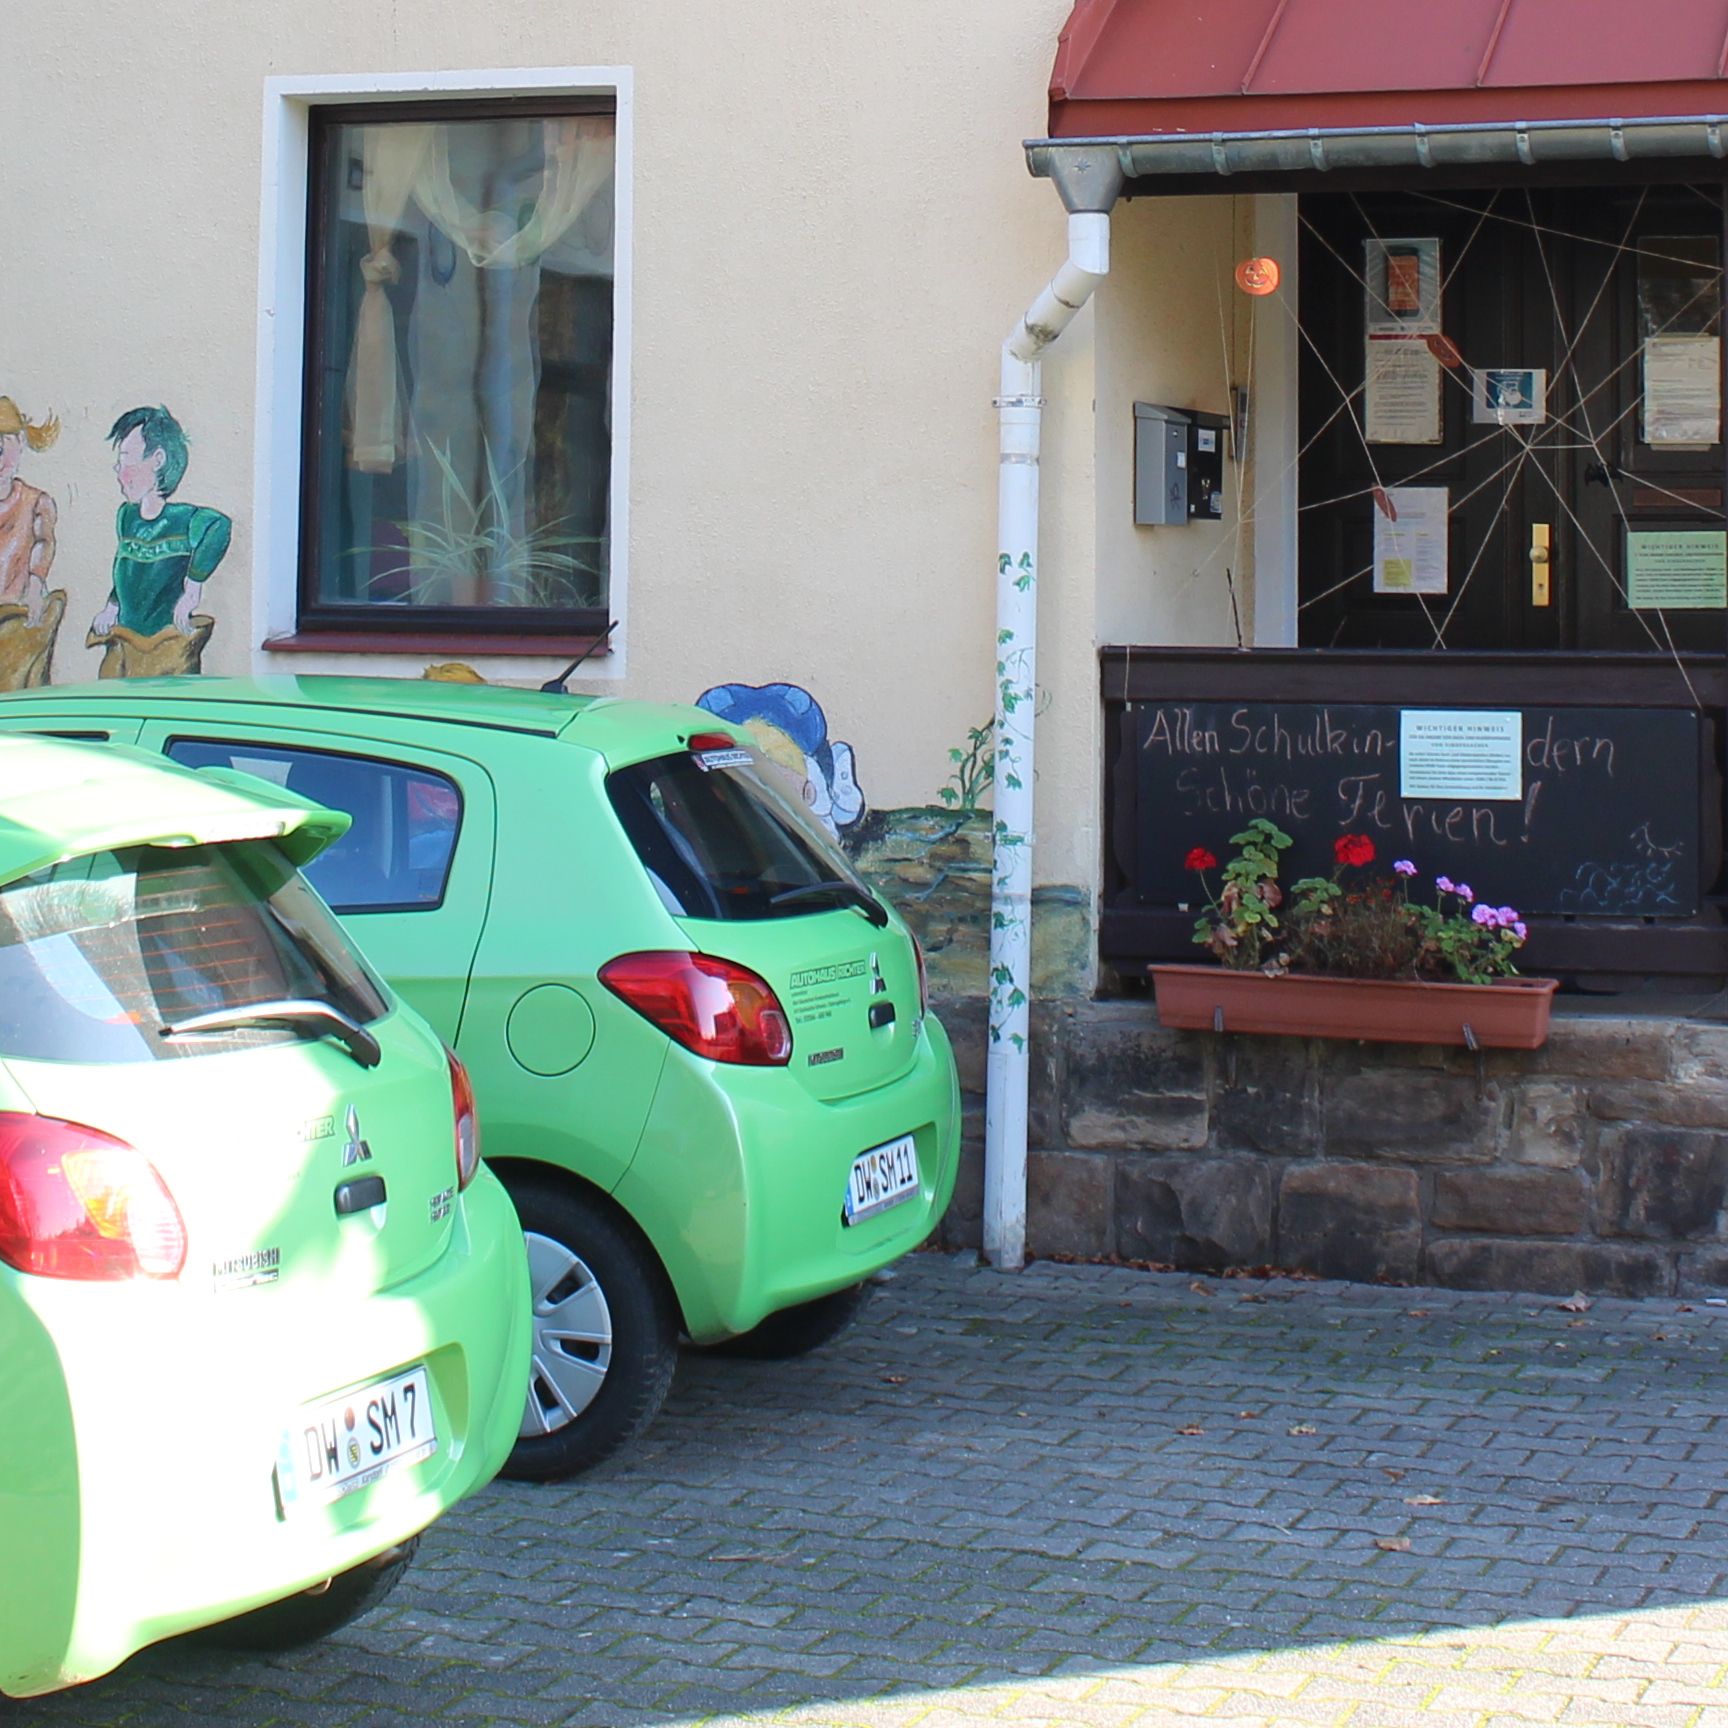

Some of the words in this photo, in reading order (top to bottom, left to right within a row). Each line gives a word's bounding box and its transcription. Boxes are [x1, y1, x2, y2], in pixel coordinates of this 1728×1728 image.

[1142, 709, 1220, 758] Allen
[1526, 715, 1617, 776] dern
[1176, 768, 1311, 821] Schöne
[790, 965, 836, 989] AUTOHAUS
[854, 1156, 873, 1204] DW
[878, 1149, 898, 1194] SM
[896, 1143, 913, 1186] 11
[303, 1417, 340, 1482] DW
[366, 1390, 401, 1456] SM
[402, 1381, 416, 1439] 7
